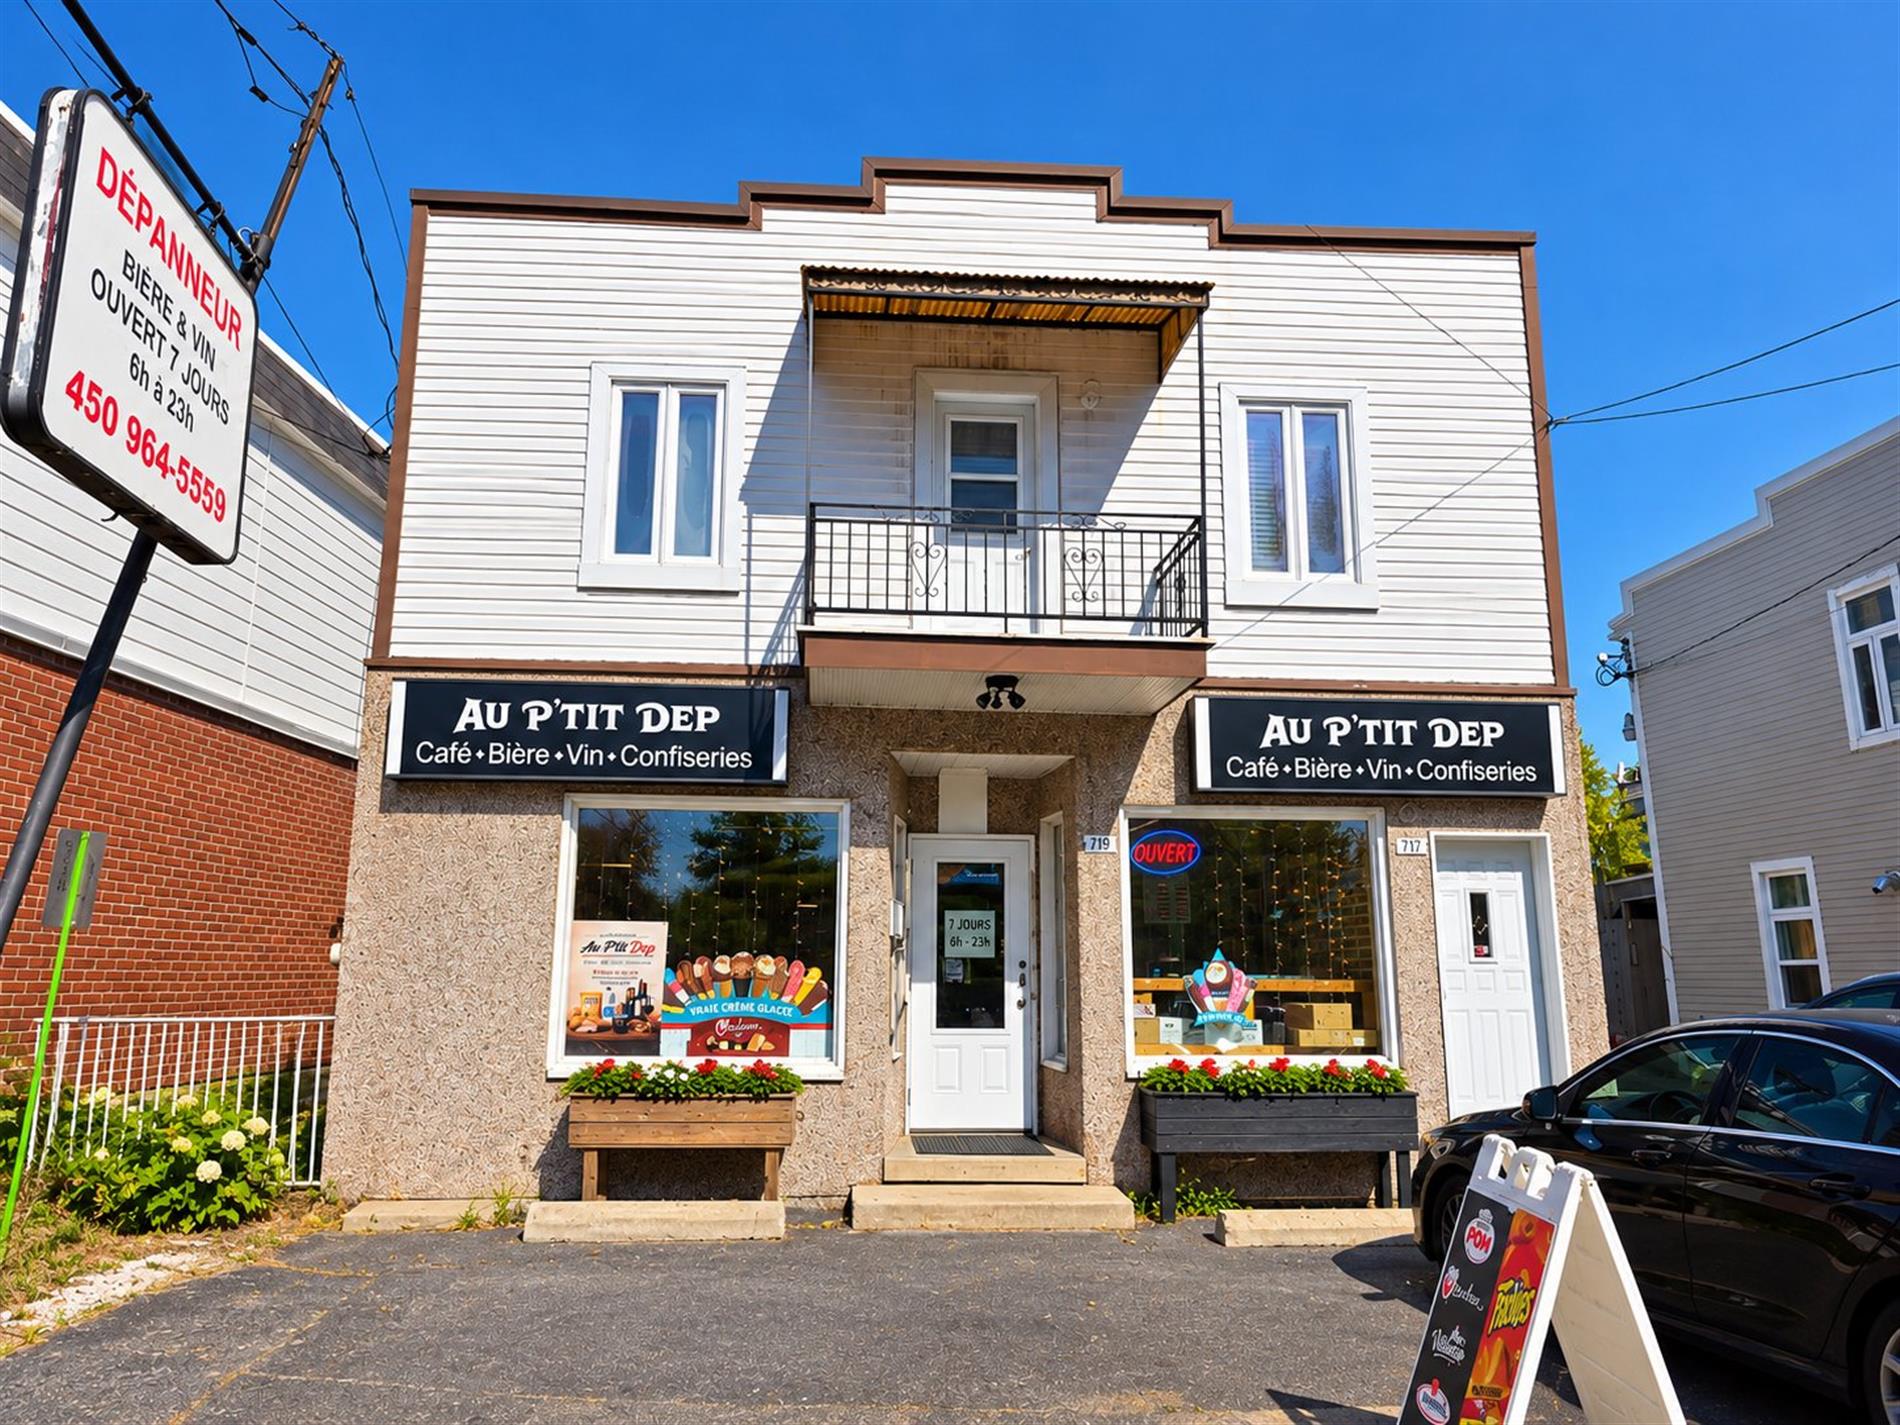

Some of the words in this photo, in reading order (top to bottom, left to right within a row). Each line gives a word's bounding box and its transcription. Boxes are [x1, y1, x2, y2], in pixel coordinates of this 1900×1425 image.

[96, 146, 241, 351] DÉPANNEUR
[122, 249, 174, 326] BIÈRE
[176, 310, 187, 341] &
[192, 323, 216, 372] VIN
[91, 268, 167, 359] OUVERT
[170, 344, 180, 371] 7
[181, 362, 229, 425] JOURS
[129, 353, 149, 391] 6h
[153, 375, 163, 405] à
[167, 389, 194, 432] 23h
[65, 370, 119, 436] 450
[126, 415, 226, 523] 964-5559
[452, 698, 511, 733] AU
[521, 698, 625, 732] P'TIT
[635, 702, 720, 733] DEP
[1259, 713, 1312, 748] AU
[1322, 714, 1418, 747] P'TIT
[1427, 717, 1505, 748] DEP
[416, 741, 472, 764] Café
[488, 742, 550, 766] Bière
[566, 743, 604, 766] Vin
[620, 744, 752, 769] Confiseries
[1226, 756, 1279, 778] Café
[1295, 757, 1352, 779] Bière
[1366, 758, 1402, 780] Vin
[1416, 759, 1537, 782] Confiseries
[1090, 837, 1110, 850] 719
[1133, 842, 1196, 864] OUVERT
[1401, 839, 1421, 852] 717
[948, 918, 955, 930] 7
[957, 918, 991, 930] JOURS
[949, 936, 962, 947] 6h
[972, 936, 991, 947] 23h
[1466, 1225, 1493, 1254] POM
